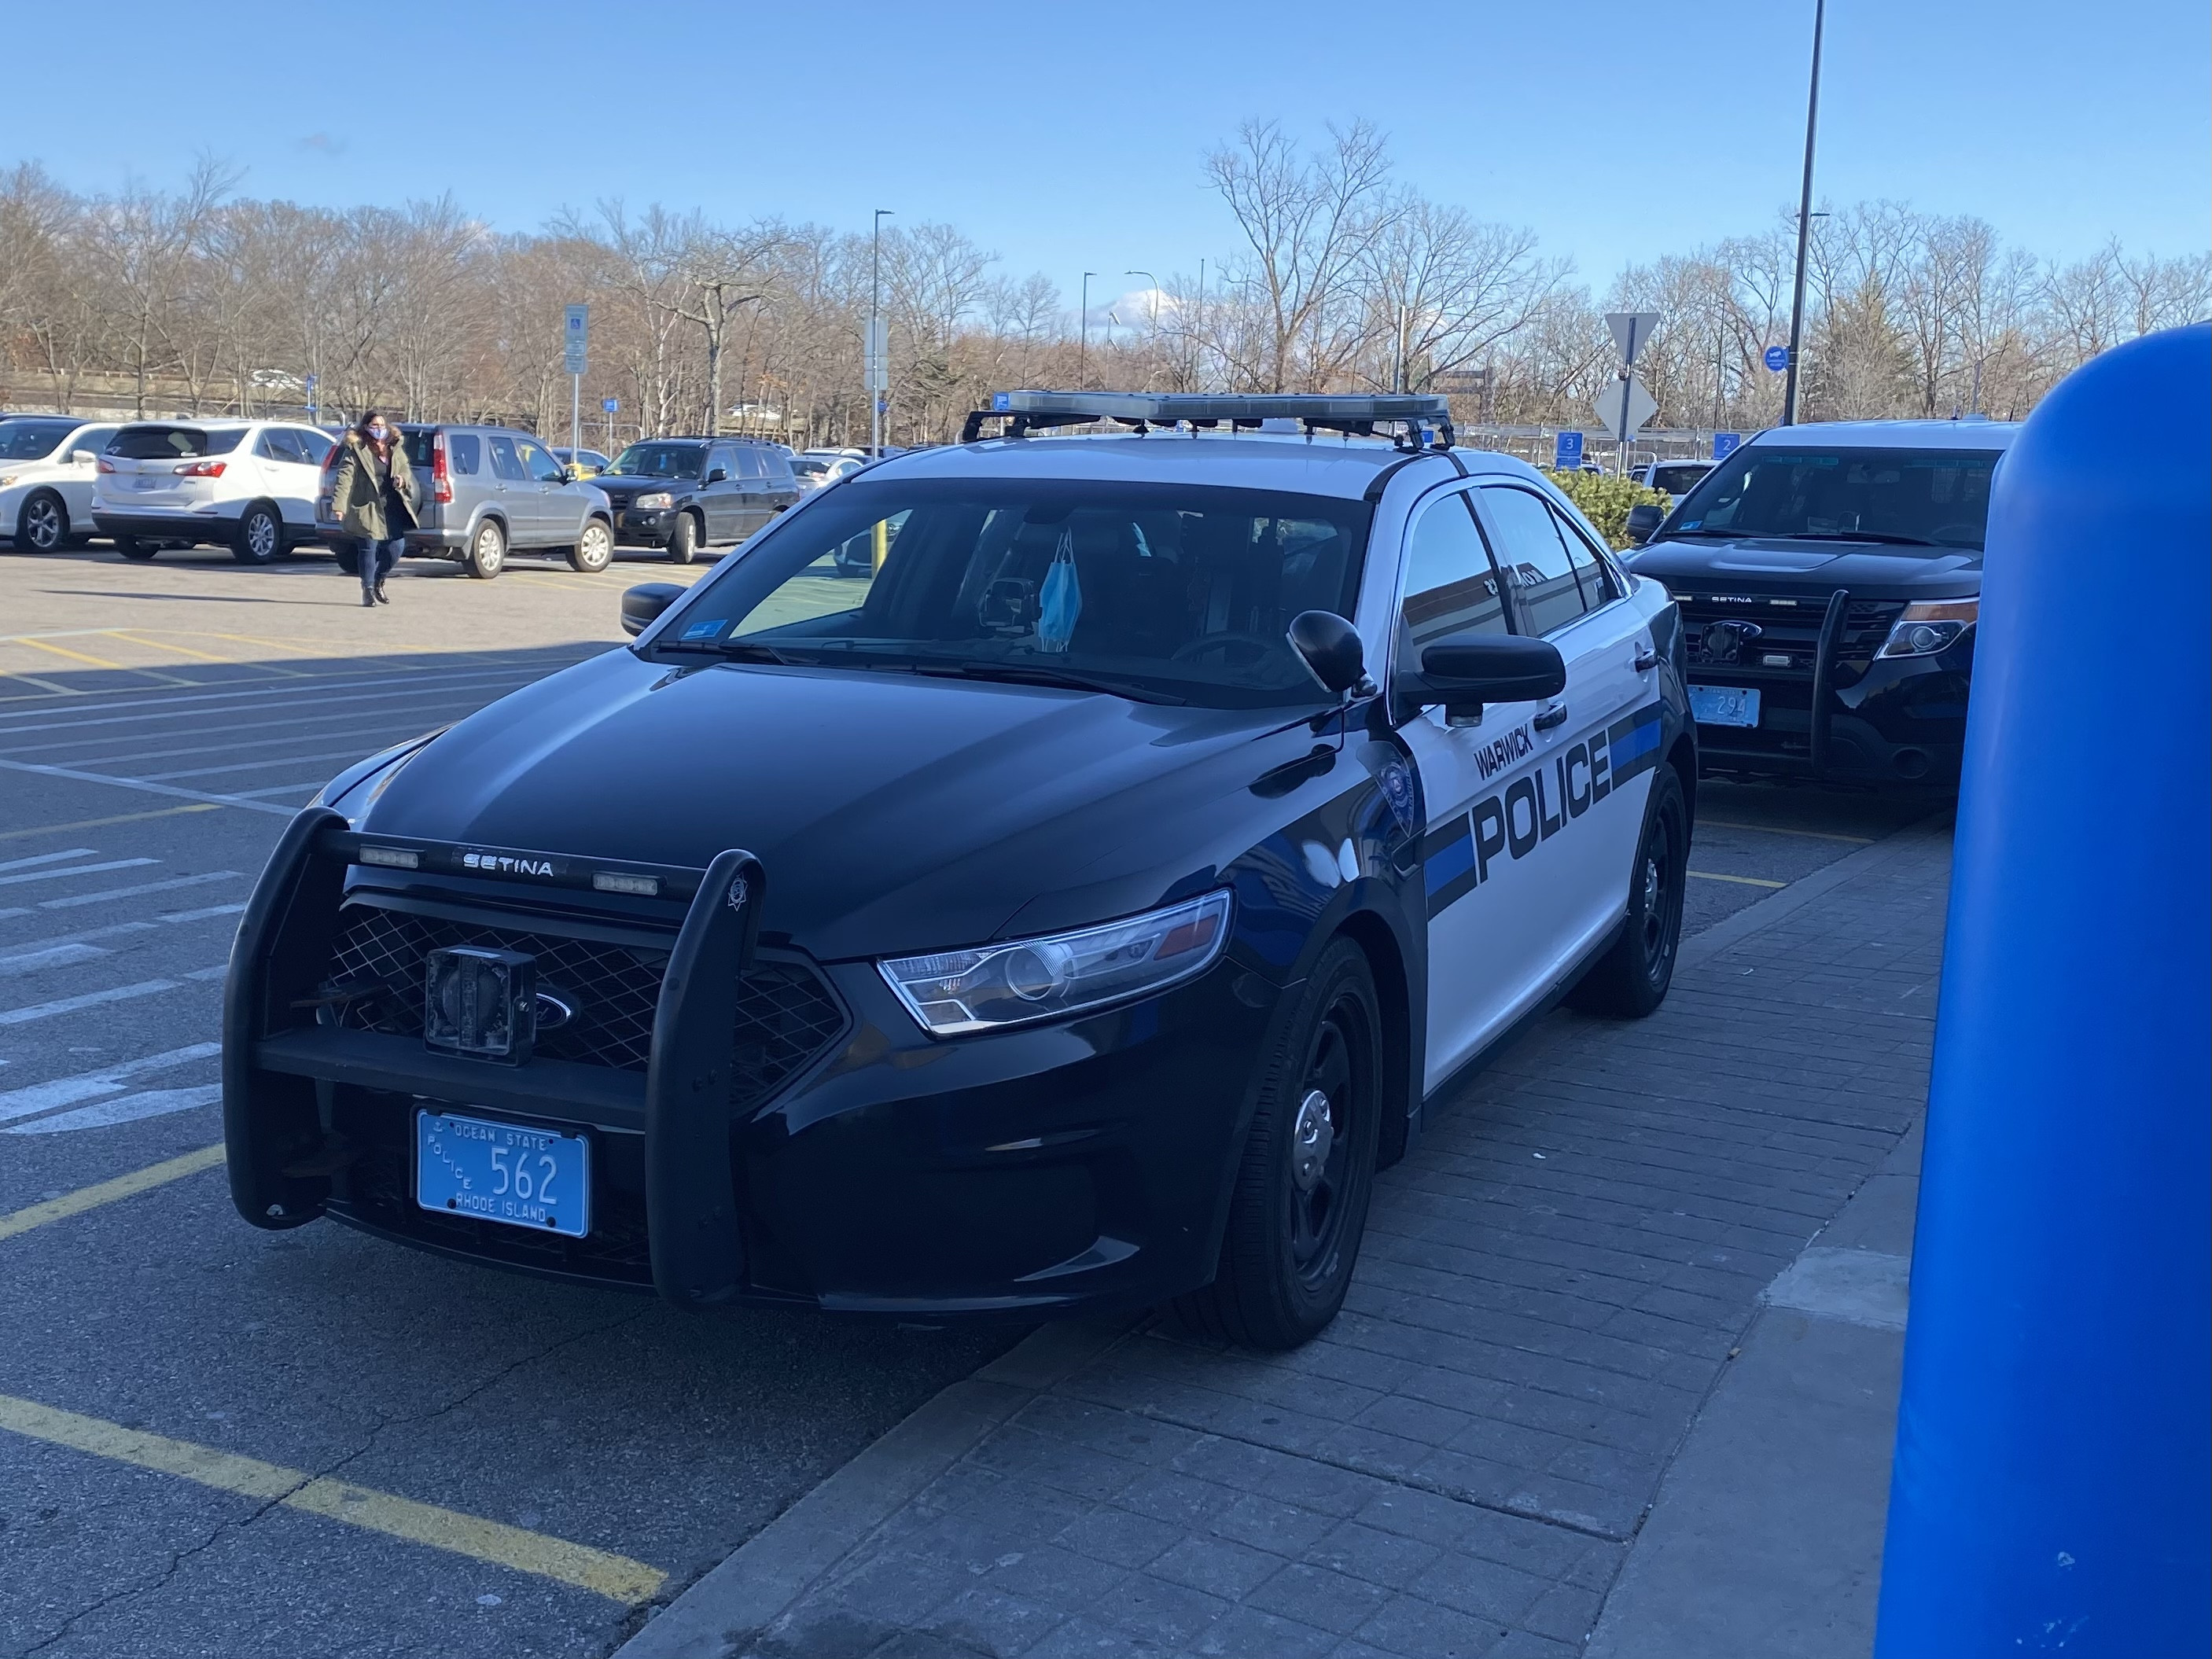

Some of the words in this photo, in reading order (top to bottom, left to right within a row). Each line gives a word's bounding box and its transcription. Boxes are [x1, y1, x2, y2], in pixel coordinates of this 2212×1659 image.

[1566, 438, 1573, 450] 3
[1723, 439, 1732, 451] 2
[1717, 696, 1746, 715] 294
[1473, 723, 1533, 781] WARWICK
[1472, 729, 1611, 884] POLICE
[463, 853, 554, 877] SETINA
[455, 1124, 496, 1142] OCEAN
[506, 1132, 547, 1151] STATE
[427, 1135, 472, 1190] POLICE
[491, 1146, 558, 1205] 562
[455, 1193, 496, 1213] RHODE
[502, 1200, 547, 1223] ISLAND
